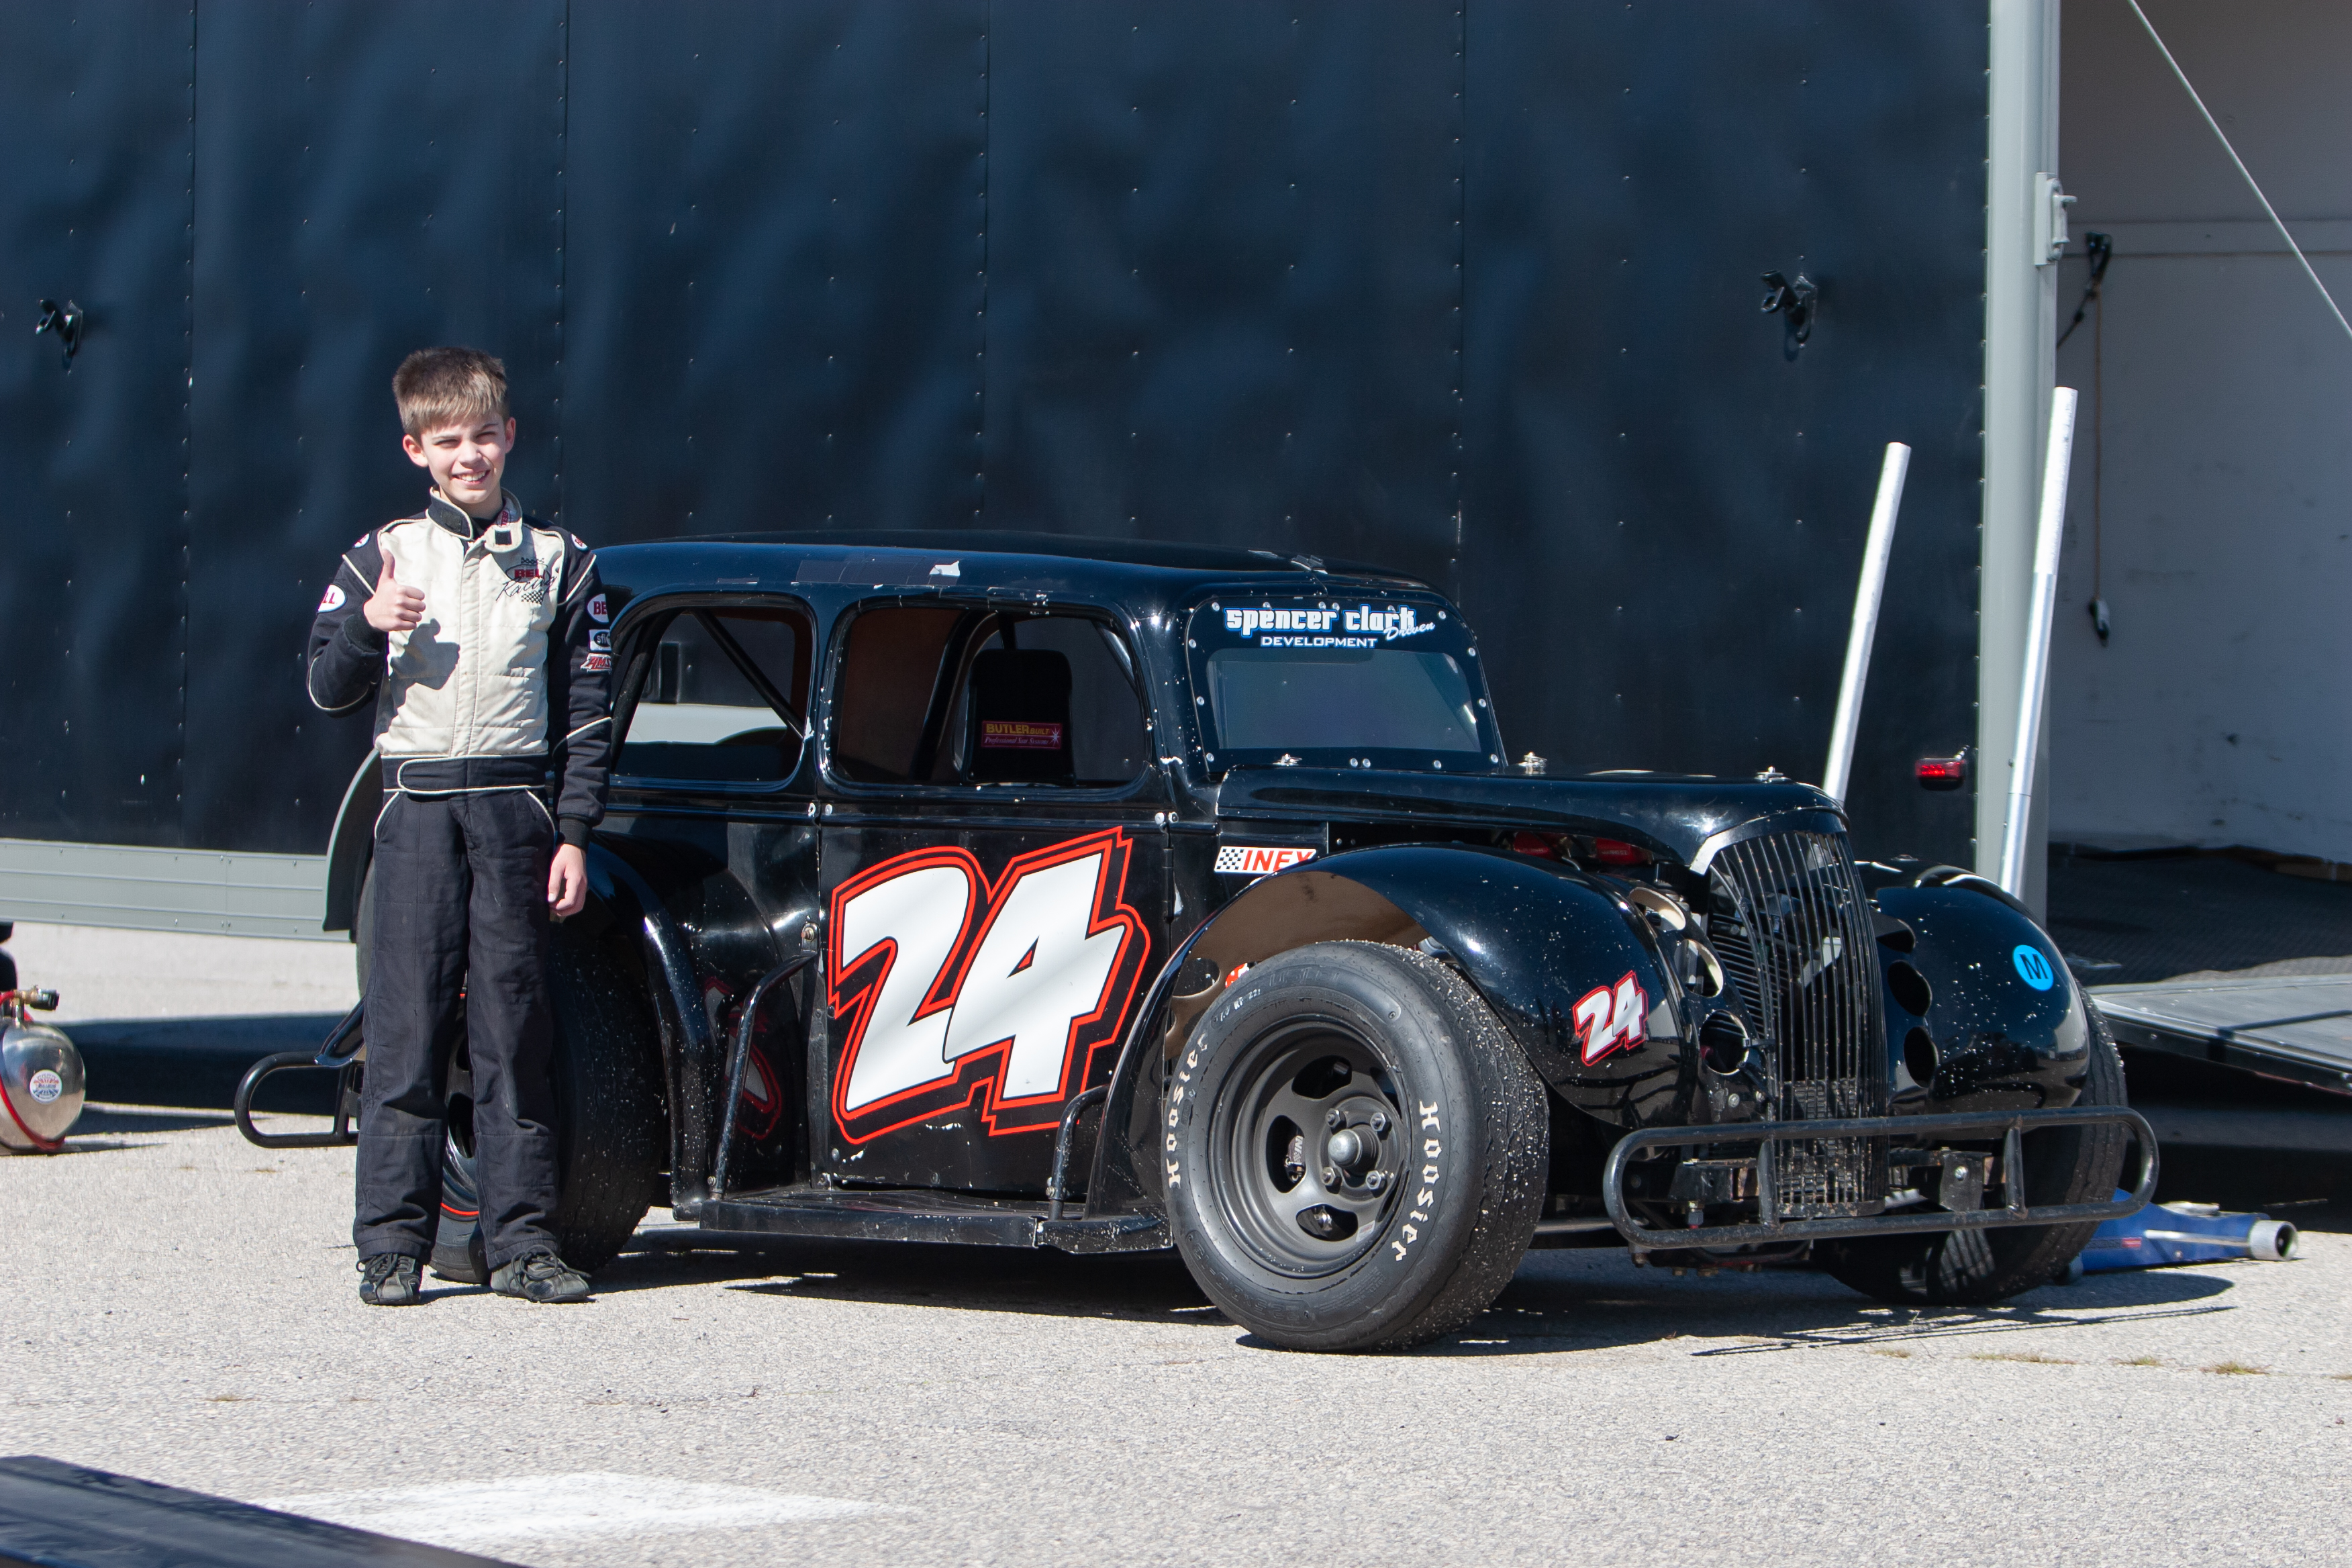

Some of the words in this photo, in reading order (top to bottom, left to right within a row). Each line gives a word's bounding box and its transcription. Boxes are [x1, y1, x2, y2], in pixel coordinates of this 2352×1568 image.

[1224, 607, 1338, 638] spencer
[1344, 605, 1416, 632] clark
[1261, 636, 1377, 648] DEVELOPMENT
[1384, 621, 1435, 642] Driven
[836, 839, 1138, 1130] 24
[2019, 953, 2049, 980] M
[1575, 974, 1647, 1064] 24
[1165, 1034, 1210, 1189] Hoosier
[1391, 1100, 1444, 1262] Hoosier
